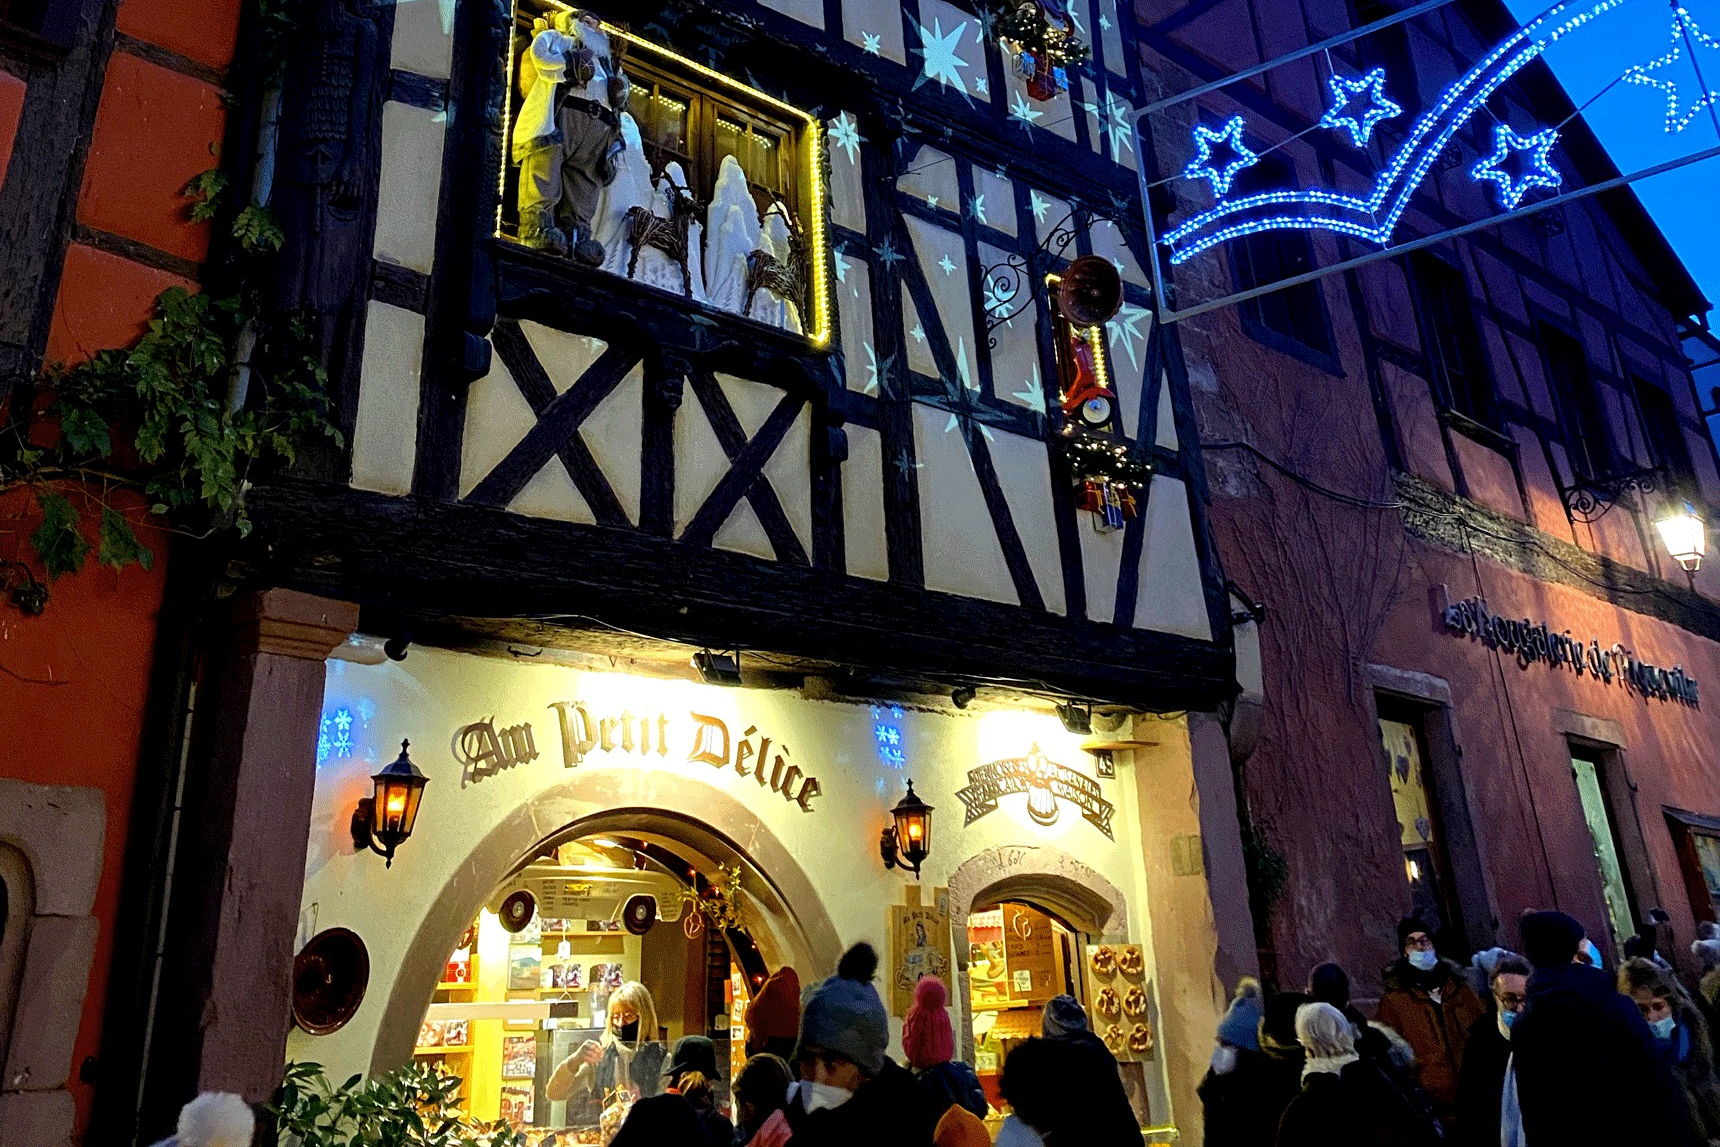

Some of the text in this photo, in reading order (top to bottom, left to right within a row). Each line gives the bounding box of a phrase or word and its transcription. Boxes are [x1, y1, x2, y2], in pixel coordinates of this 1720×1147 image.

[1438, 583, 1472, 633] La
[547, 700, 670, 769] Petit
[687, 711, 822, 813] Délice
[1098, 756, 1113, 775] 45
